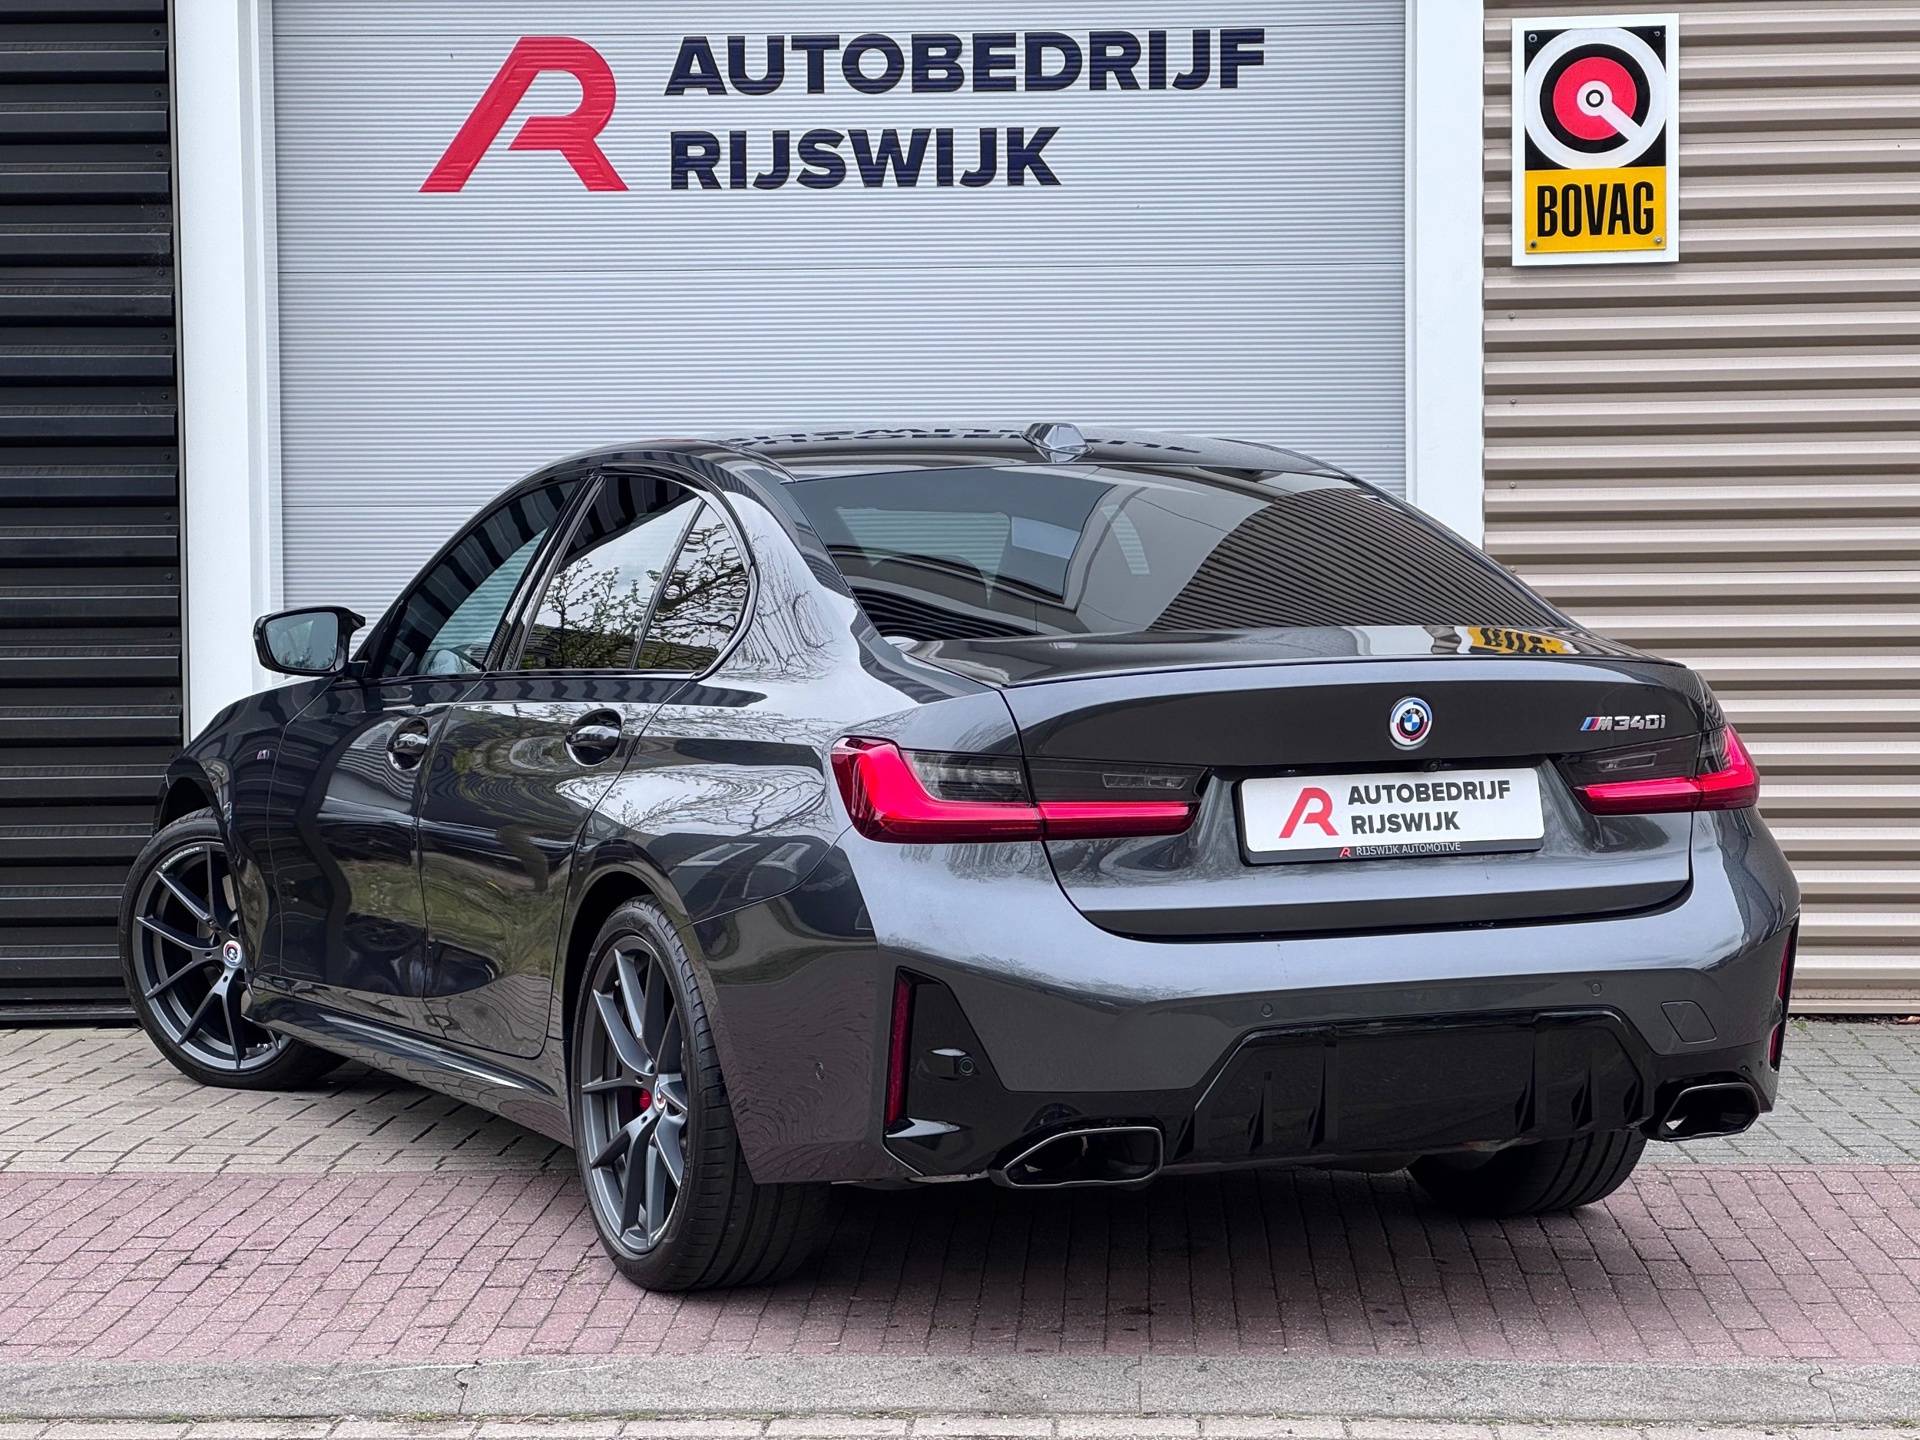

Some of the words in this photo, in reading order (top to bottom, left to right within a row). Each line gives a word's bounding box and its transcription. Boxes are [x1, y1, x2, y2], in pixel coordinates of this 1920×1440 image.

[664, 28, 1266, 96] AUTOBEDRIJF
[670, 126, 1062, 191] RIJSWIJK
[1537, 181, 1655, 238] BOVAG
[1594, 714, 1666, 731] M340i
[1348, 780, 1512, 806] AUTOBEDRIJF
[1350, 811, 1461, 835] RIJSWIJK
[1356, 845, 1400, 857] RIJSWIJK
[1401, 842, 1462, 854] AUTOMOTIVE
